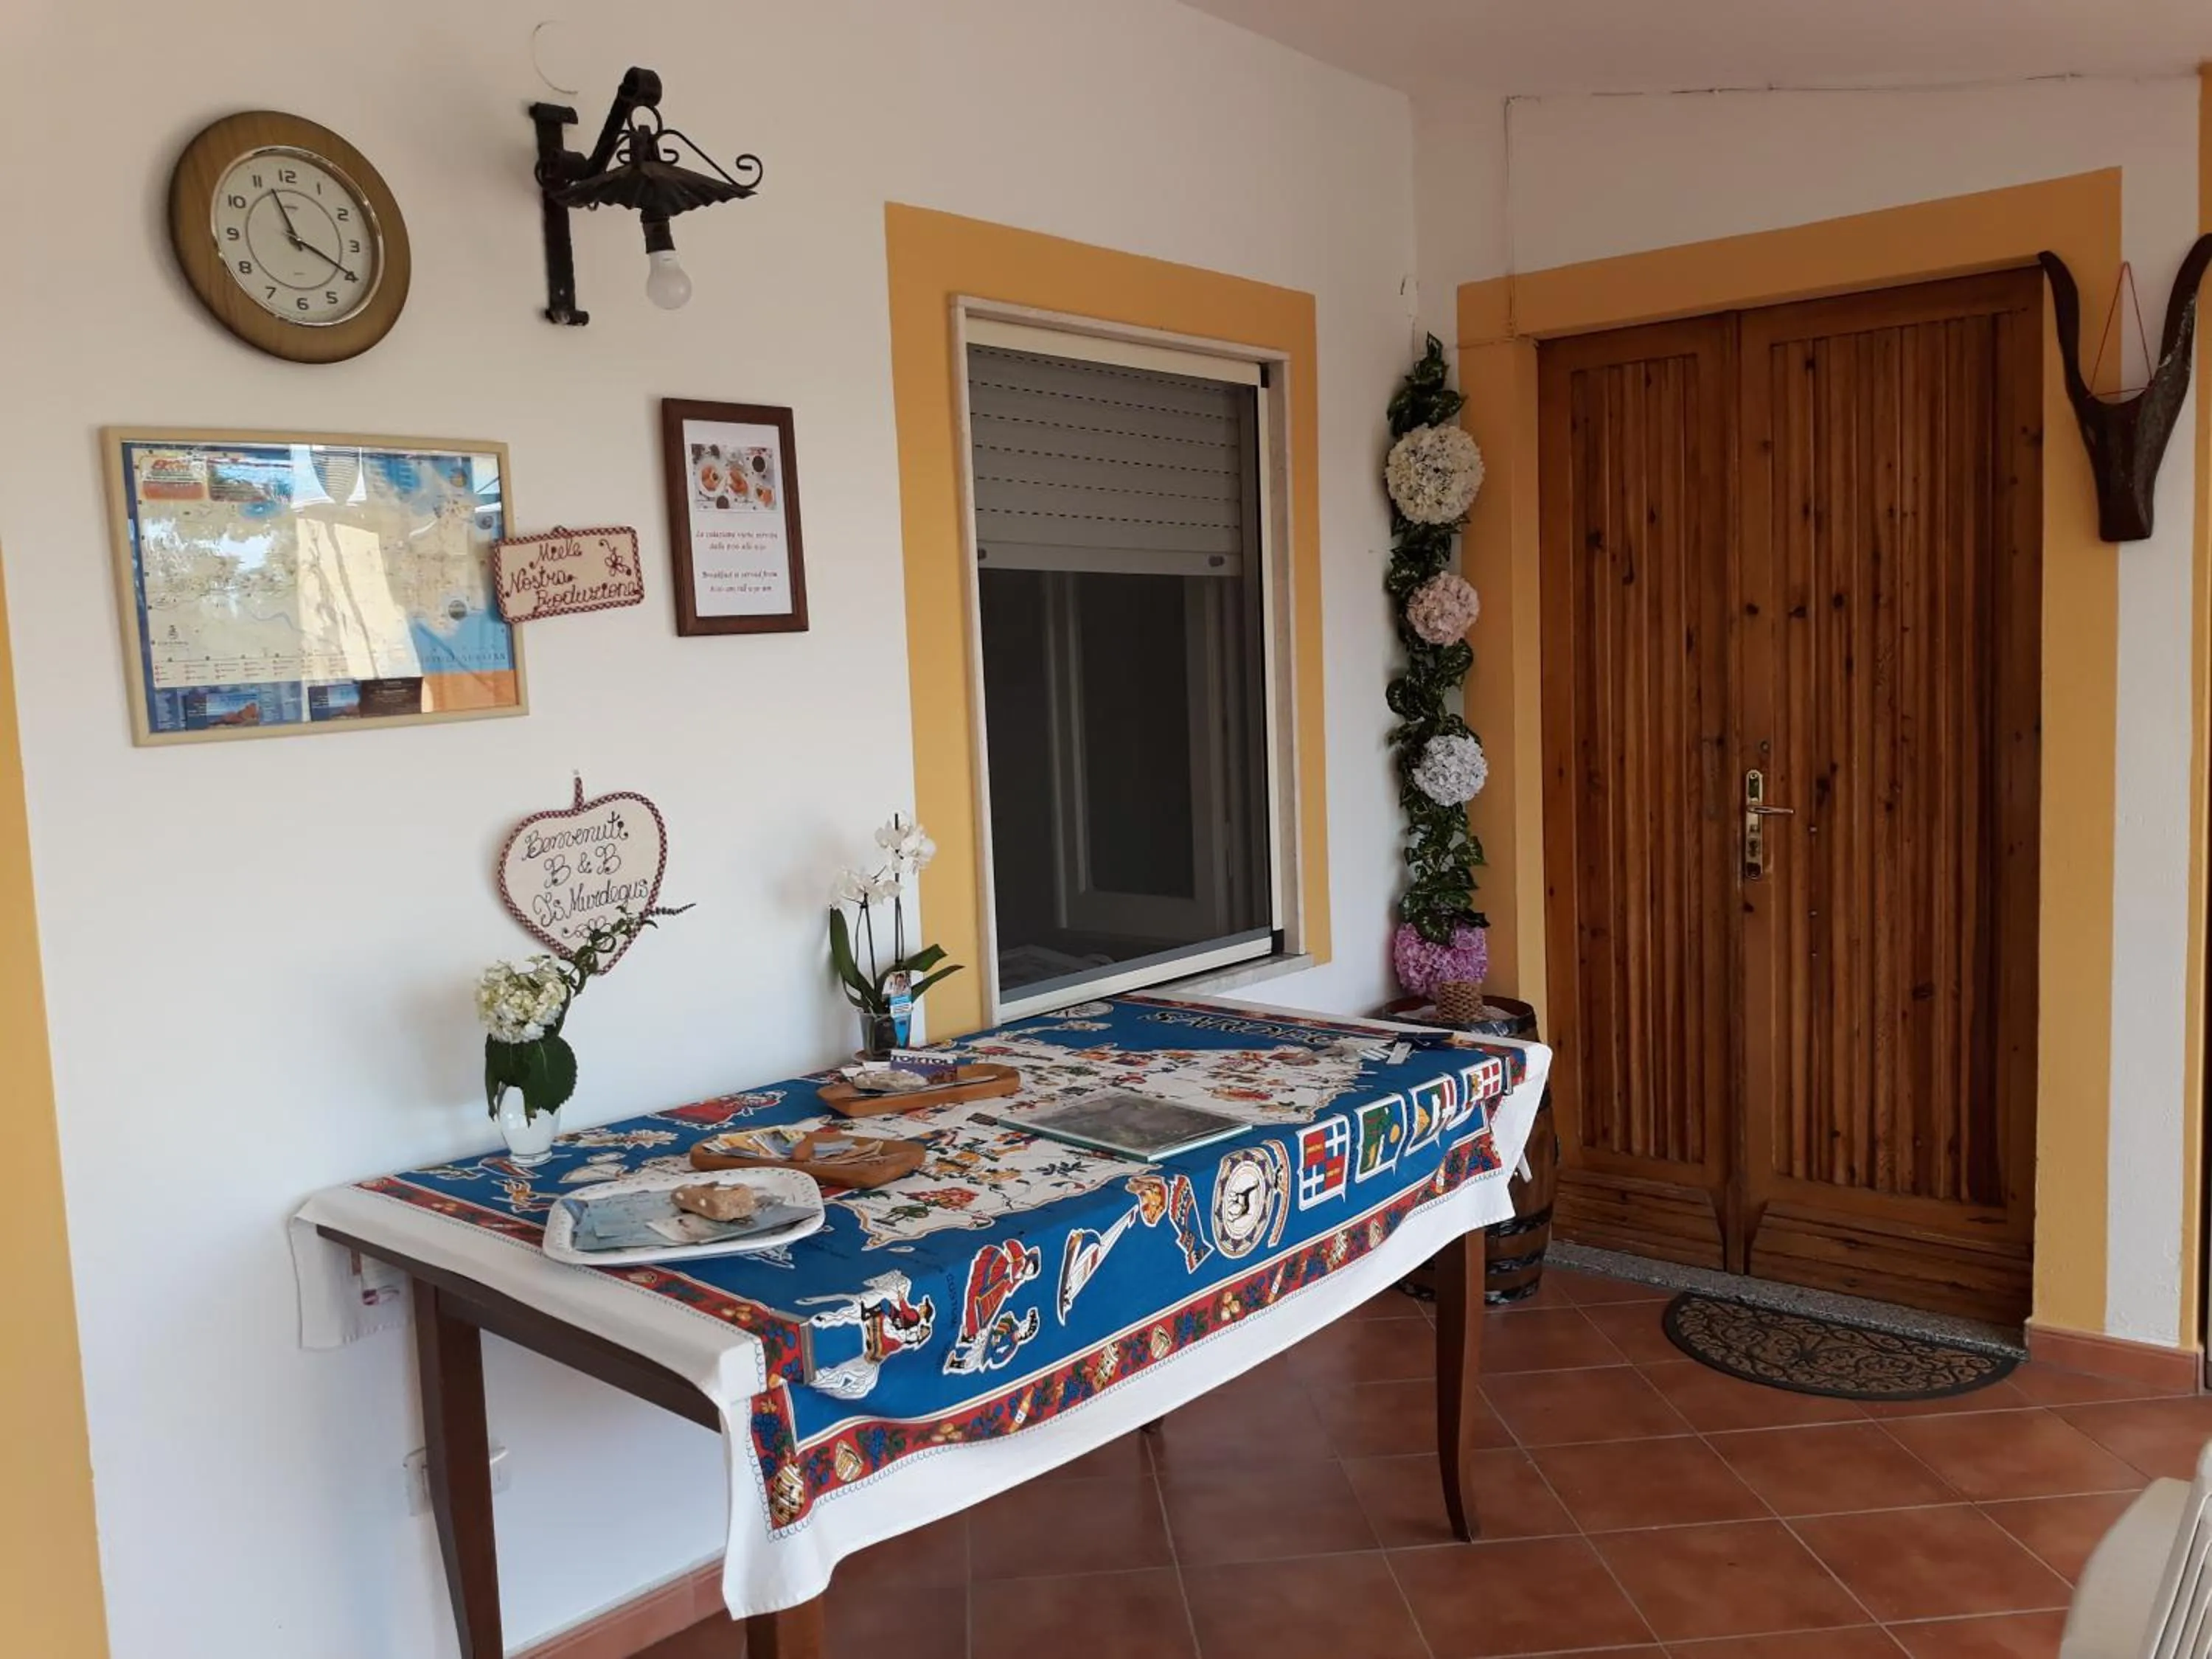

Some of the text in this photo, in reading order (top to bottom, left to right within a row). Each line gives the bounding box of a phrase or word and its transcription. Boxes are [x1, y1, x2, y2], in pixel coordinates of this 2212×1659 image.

[252, 175, 263, 188] 11
[279, 170, 297, 184] 12
[227, 194, 246, 209] 10
[337, 207, 349, 221] 2
[226, 227, 240, 241] 9
[349, 240, 361, 253] 3
[238, 261, 252, 274] 8
[344, 270, 359, 283] 4
[265, 286, 276, 300] 7
[326, 291, 338, 305] 5
[296, 297, 310, 310] 6
[505, 566, 577, 597] Nostra
[543, 843, 622, 888] B & B
